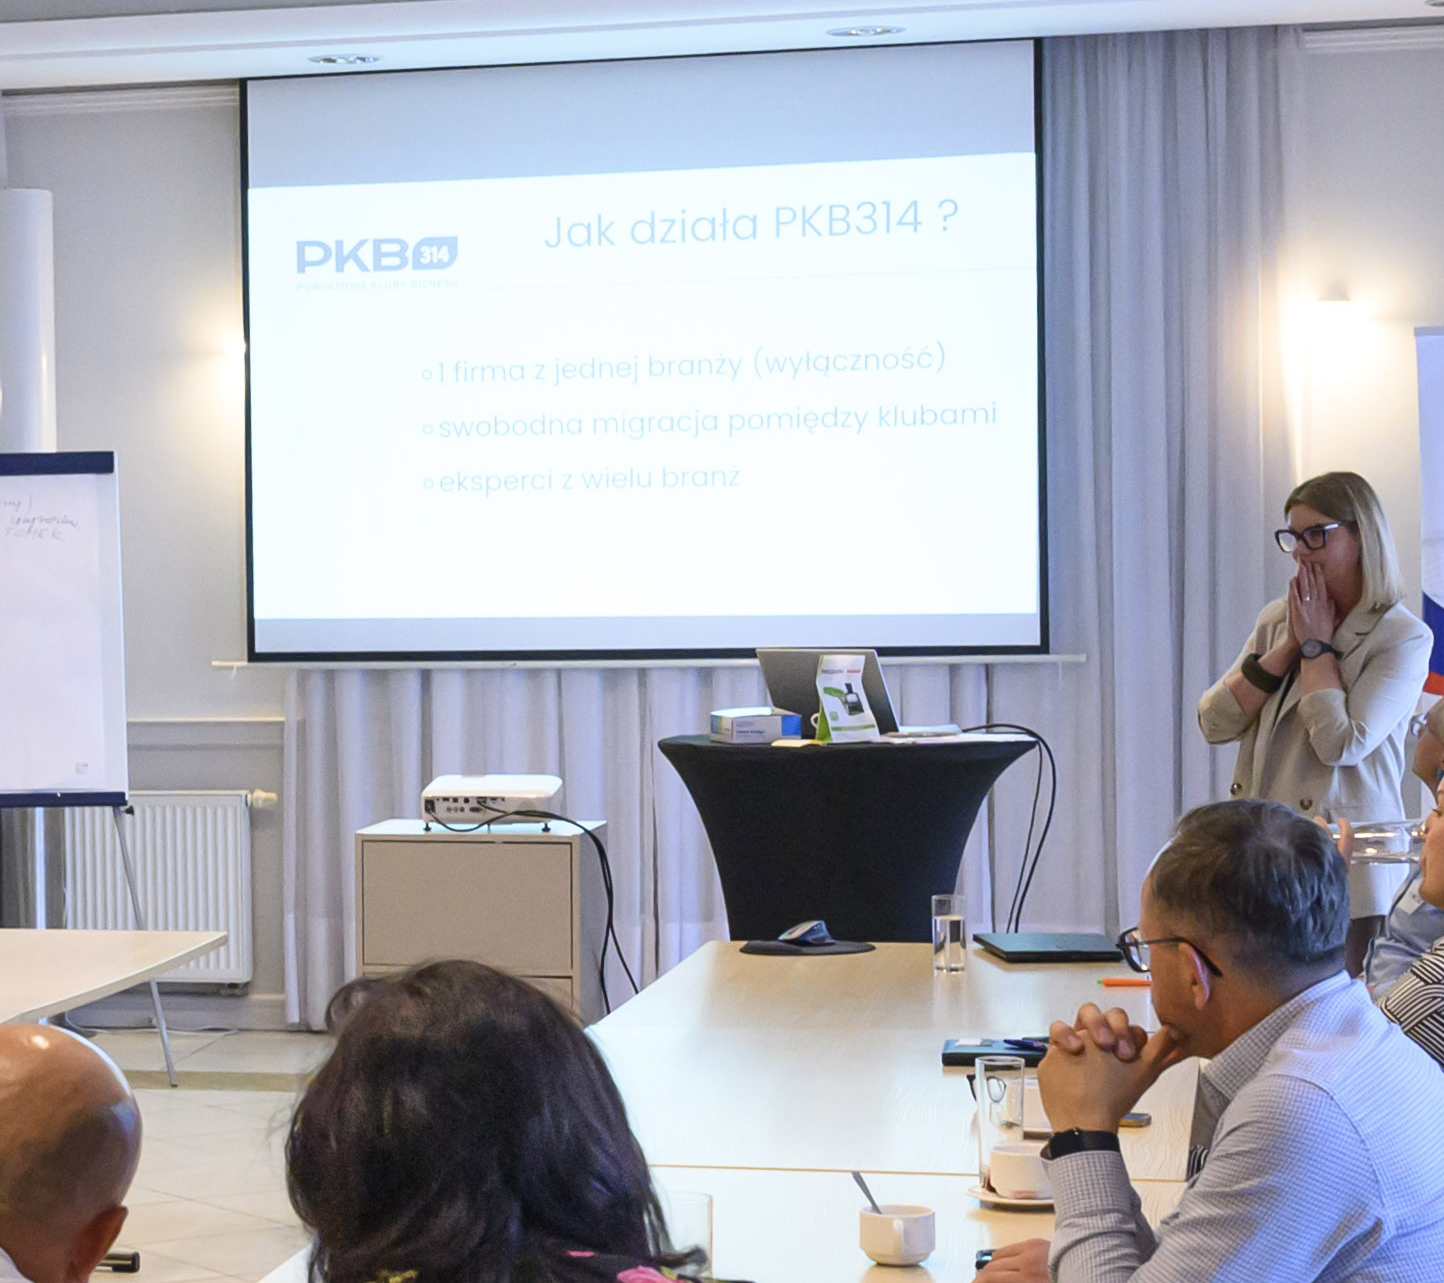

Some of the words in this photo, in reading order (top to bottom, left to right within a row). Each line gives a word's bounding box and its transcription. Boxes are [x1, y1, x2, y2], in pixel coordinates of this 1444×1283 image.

[544, 214, 616, 250] Jak
[630, 209, 758, 246] działa
[774, 200, 923, 239] PKB314
[936, 198, 960, 233] ?
[296, 238, 409, 274] PKB
[419, 245, 450, 264] 314
[454, 359, 525, 383] firma
[534, 365, 547, 380] z
[552, 355, 639, 389] jednej
[647, 351, 744, 384] branży
[753, 341, 946, 380] (wyłączność)
[439, 413, 583, 438] swobodna
[592, 410, 719, 440] migracja
[728, 407, 869, 438] pomiędzy
[878, 401, 998, 429] klubami
[439, 468, 553, 498] eksperci
[561, 475, 574, 491] z
[582, 467, 653, 489] wielu
[661, 466, 740, 489] branż
